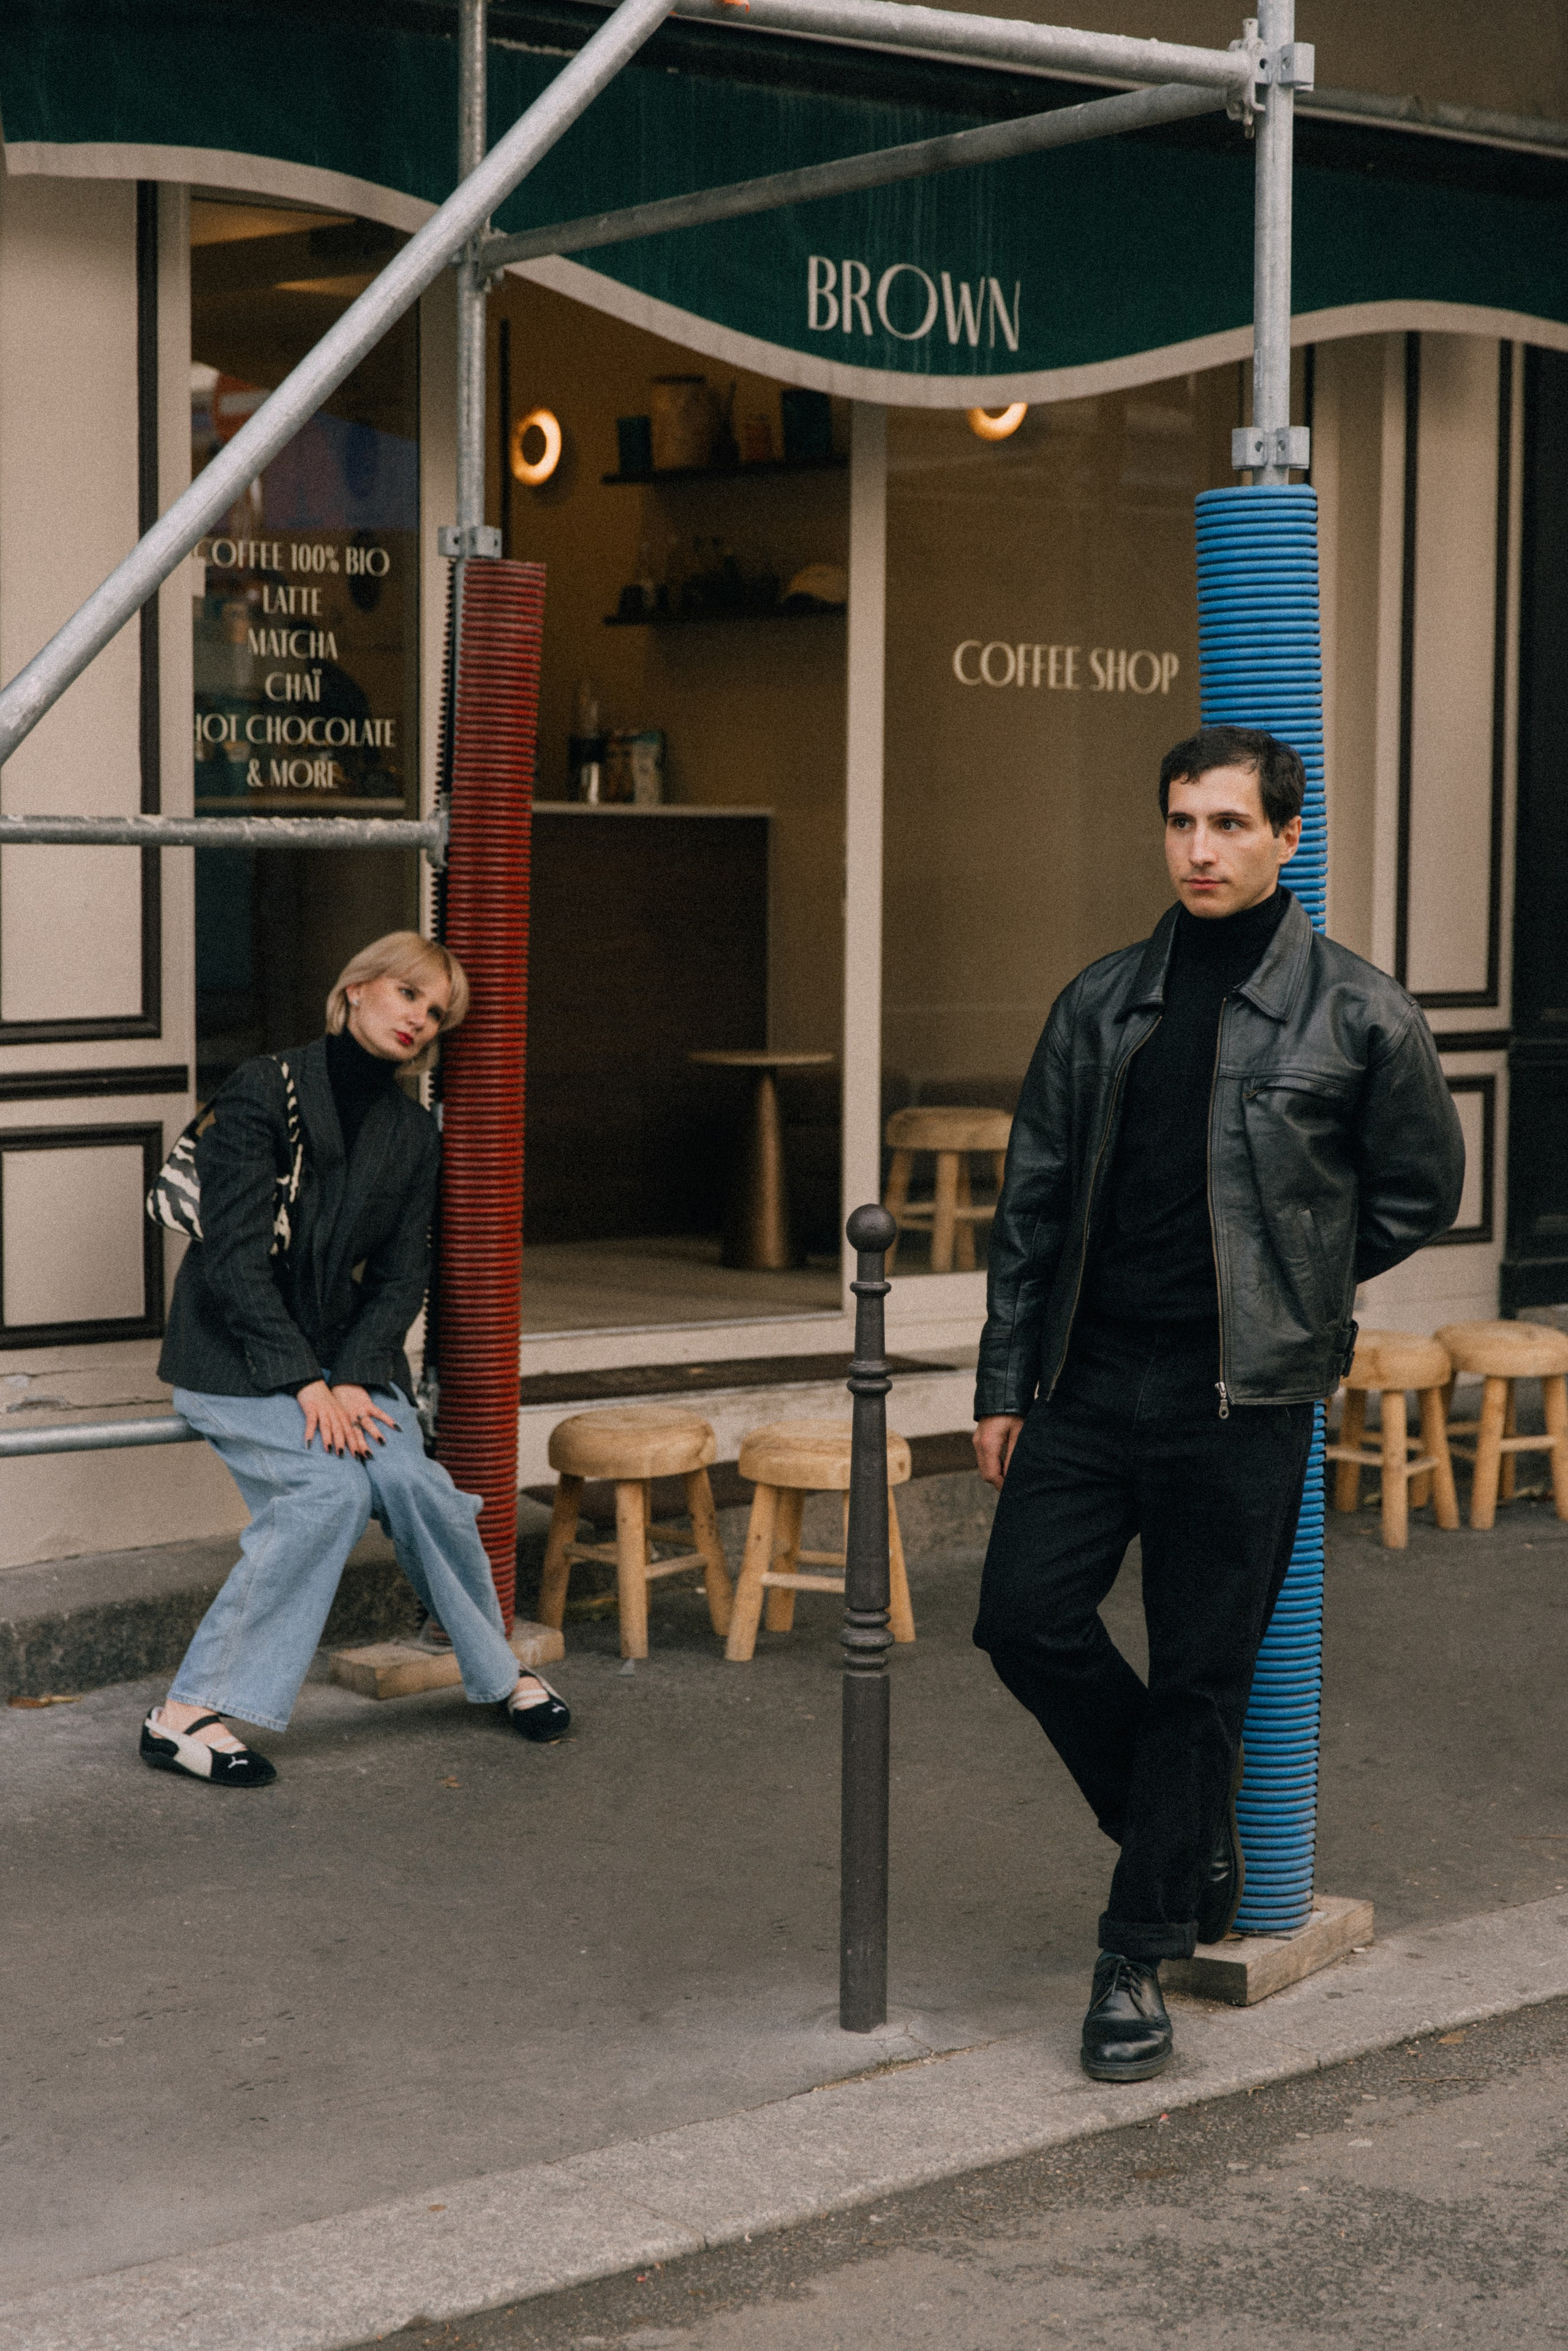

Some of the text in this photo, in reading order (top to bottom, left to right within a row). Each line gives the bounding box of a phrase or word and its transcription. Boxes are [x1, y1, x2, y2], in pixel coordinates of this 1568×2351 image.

[808, 255, 1020, 352] BROWN
[291, 543, 339, 573] 100%
[345, 546, 390, 576] BIO
[263, 585, 322, 616] LATTE
[248, 627, 337, 660] MATCHA
[952, 640, 1179, 695] COFFEE SHOP
[265, 668, 322, 702] CHAÏ
[246, 714, 396, 747] CHOCOLATE
[247, 758, 338, 788] & MORE
